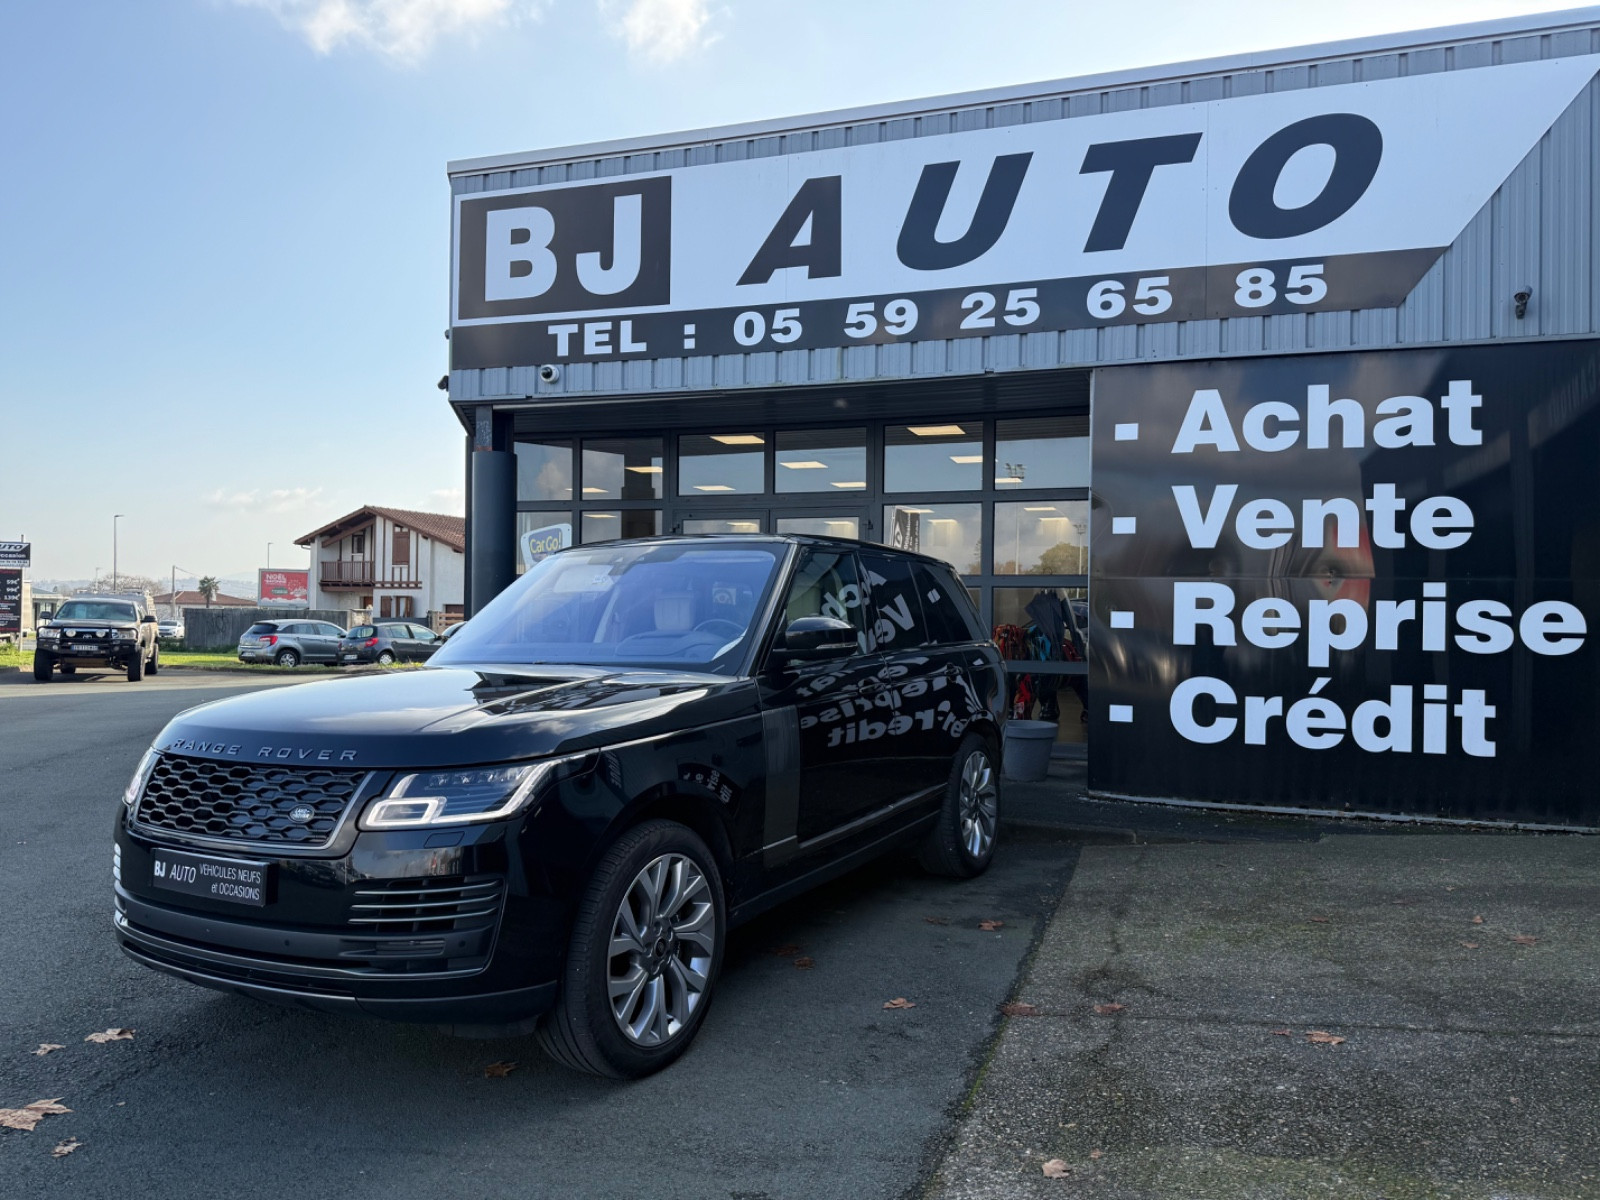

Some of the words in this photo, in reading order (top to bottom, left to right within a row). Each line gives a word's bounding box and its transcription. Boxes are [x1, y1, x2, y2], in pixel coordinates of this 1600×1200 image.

[484, 194, 642, 302] BJ
[735, 113, 1383, 286] AUTO
[548, 321, 647, 357] TEL
[733, 308, 803, 346] 05
[844, 300, 918, 338] 59
[960, 287, 1041, 330] 25
[1086, 276, 1173, 318] 65
[1234, 264, 1328, 308] 85
[1171, 380, 1483, 454] Achat
[1171, 483, 1475, 550] Vente
[1173, 582, 1588, 667] Reprise
[172, 738, 242, 755] RANGE
[257, 746, 358, 761] ROVER
[1169, 676, 1497, 757] Crédit
[154, 860, 166, 878] BJ
[169, 864, 196, 884] AUTO
[211, 884, 218, 893] et
[219, 882, 260, 901] OCCASIONS
[238, 868, 261, 884] NEUFS
